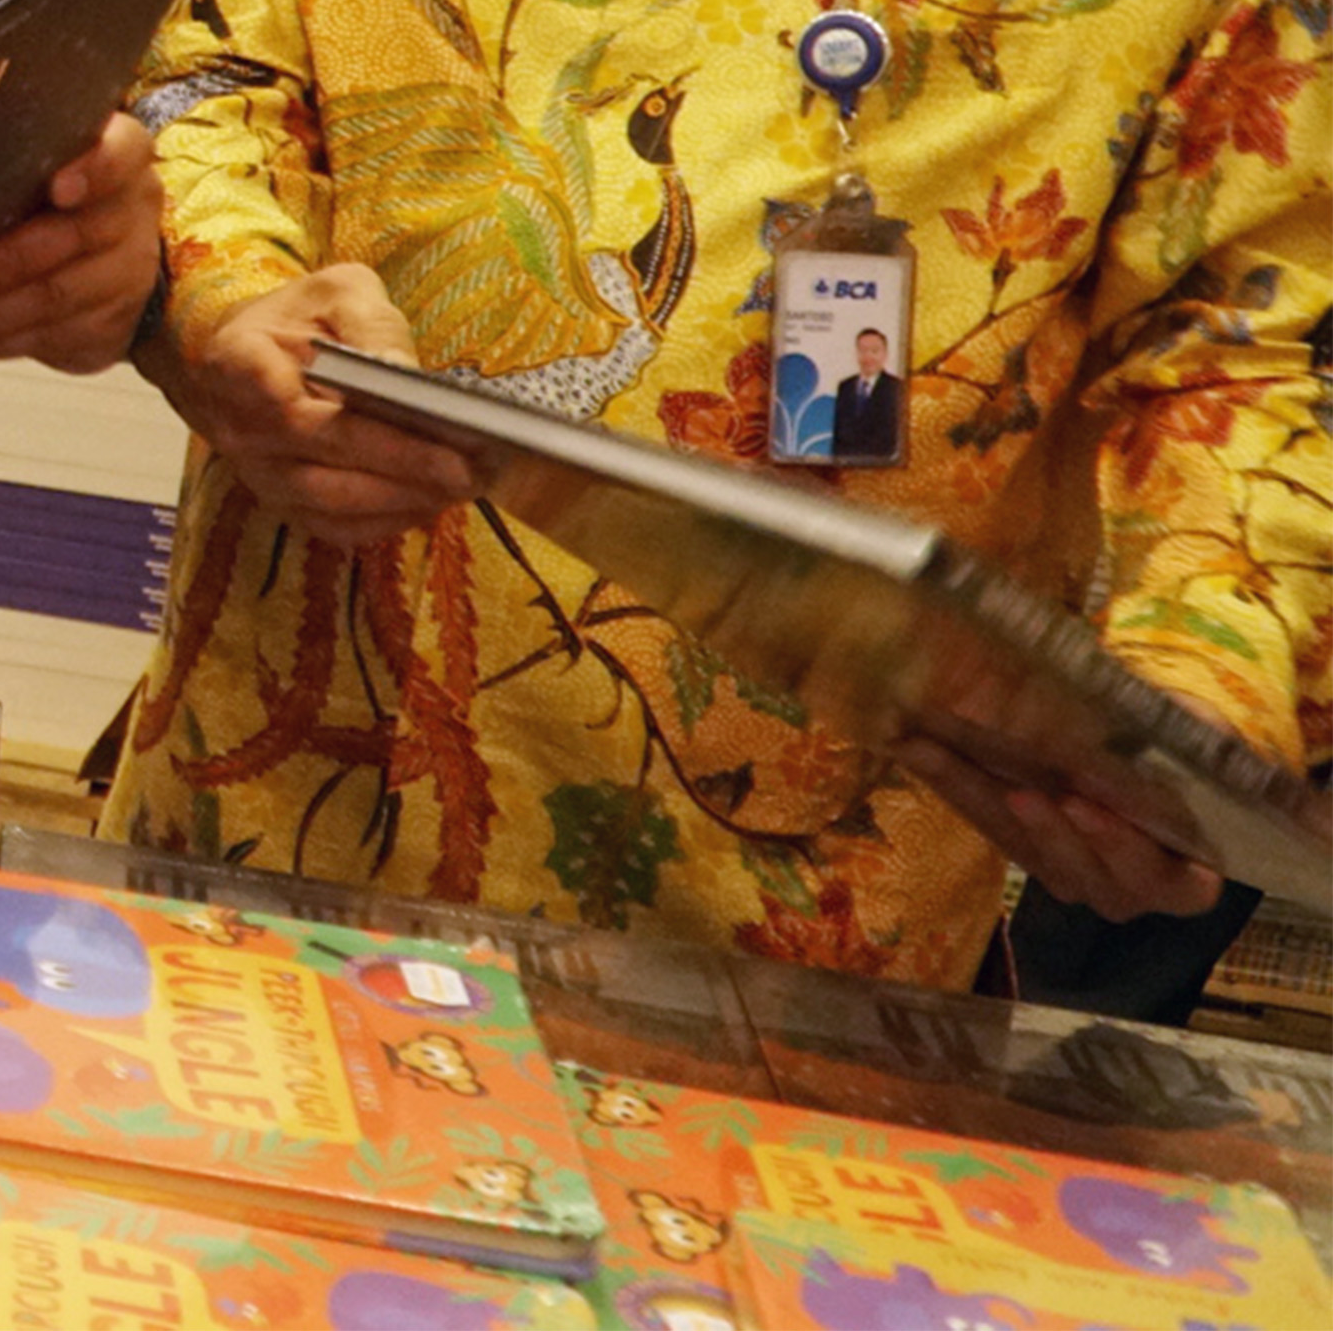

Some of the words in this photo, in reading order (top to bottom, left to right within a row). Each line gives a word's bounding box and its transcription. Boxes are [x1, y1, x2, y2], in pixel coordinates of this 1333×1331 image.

[834, 280, 877, 301] BCA
[161, 951, 280, 1123] JUNGLE
[259, 967, 342, 1132] PEEK-THROUGH
